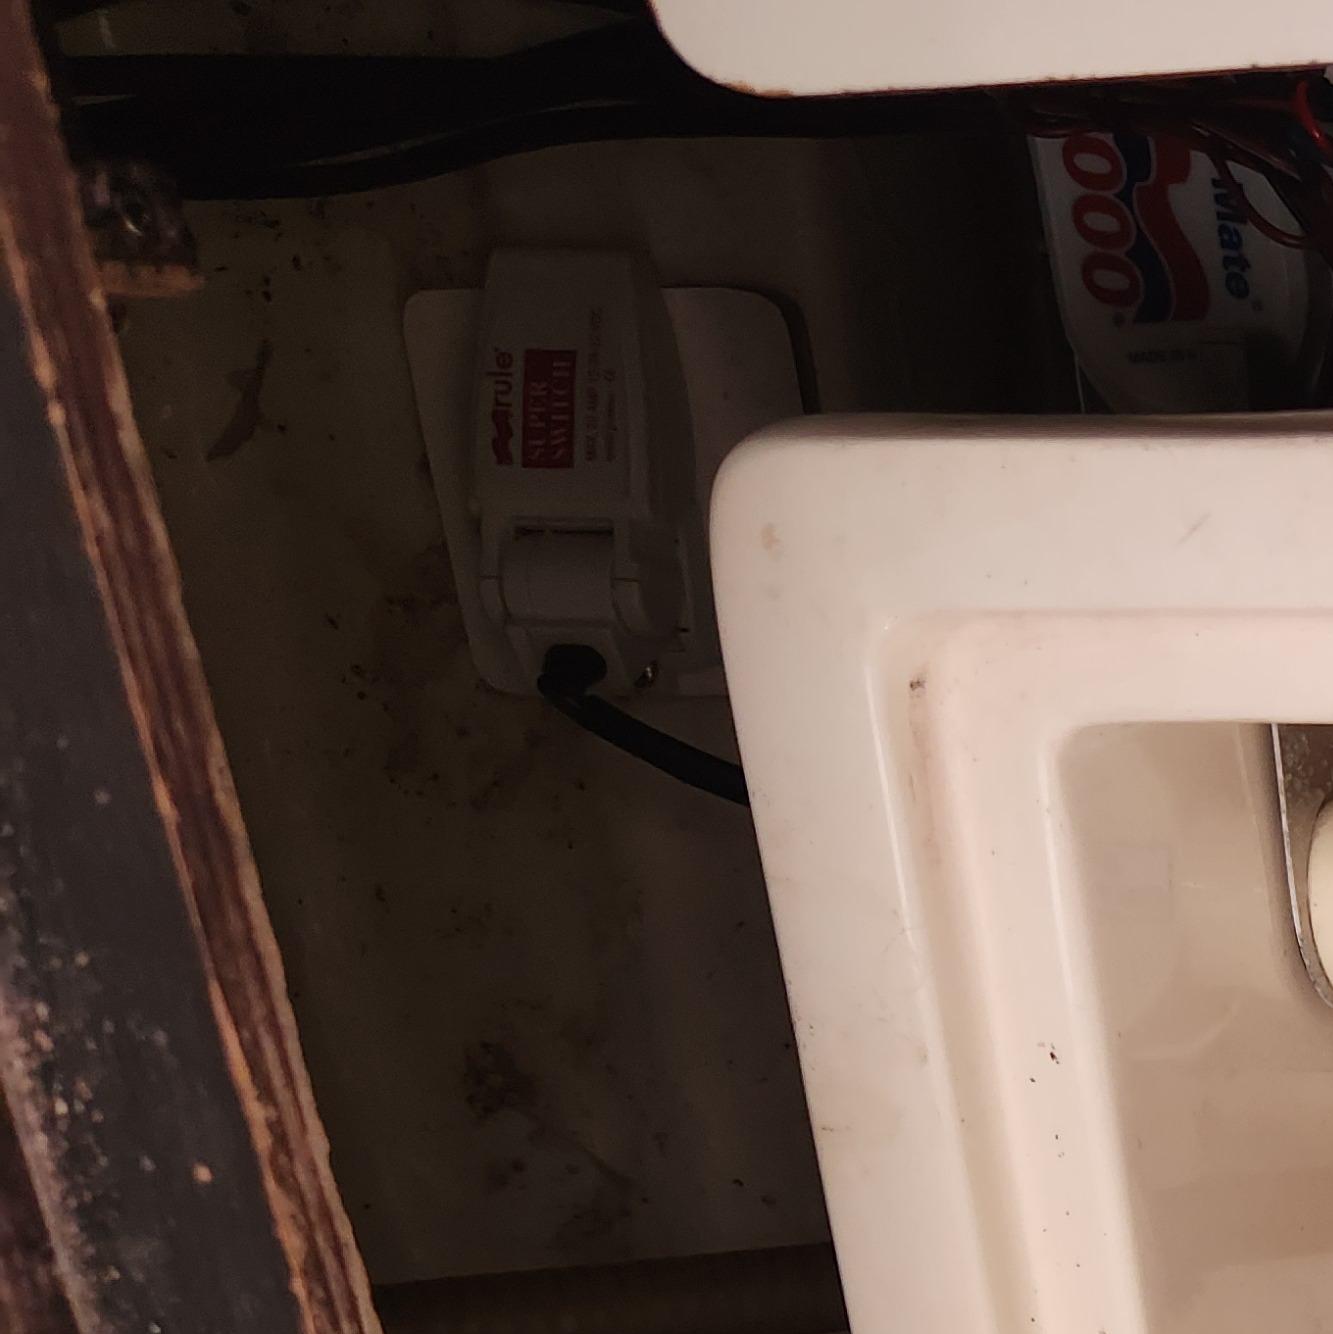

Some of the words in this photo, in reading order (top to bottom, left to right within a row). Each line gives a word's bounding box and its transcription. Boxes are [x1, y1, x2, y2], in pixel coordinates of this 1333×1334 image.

[485, 352, 513, 408] rule
[551, 360, 571, 460] SWITCH
[528, 381, 547, 460] SUPER
